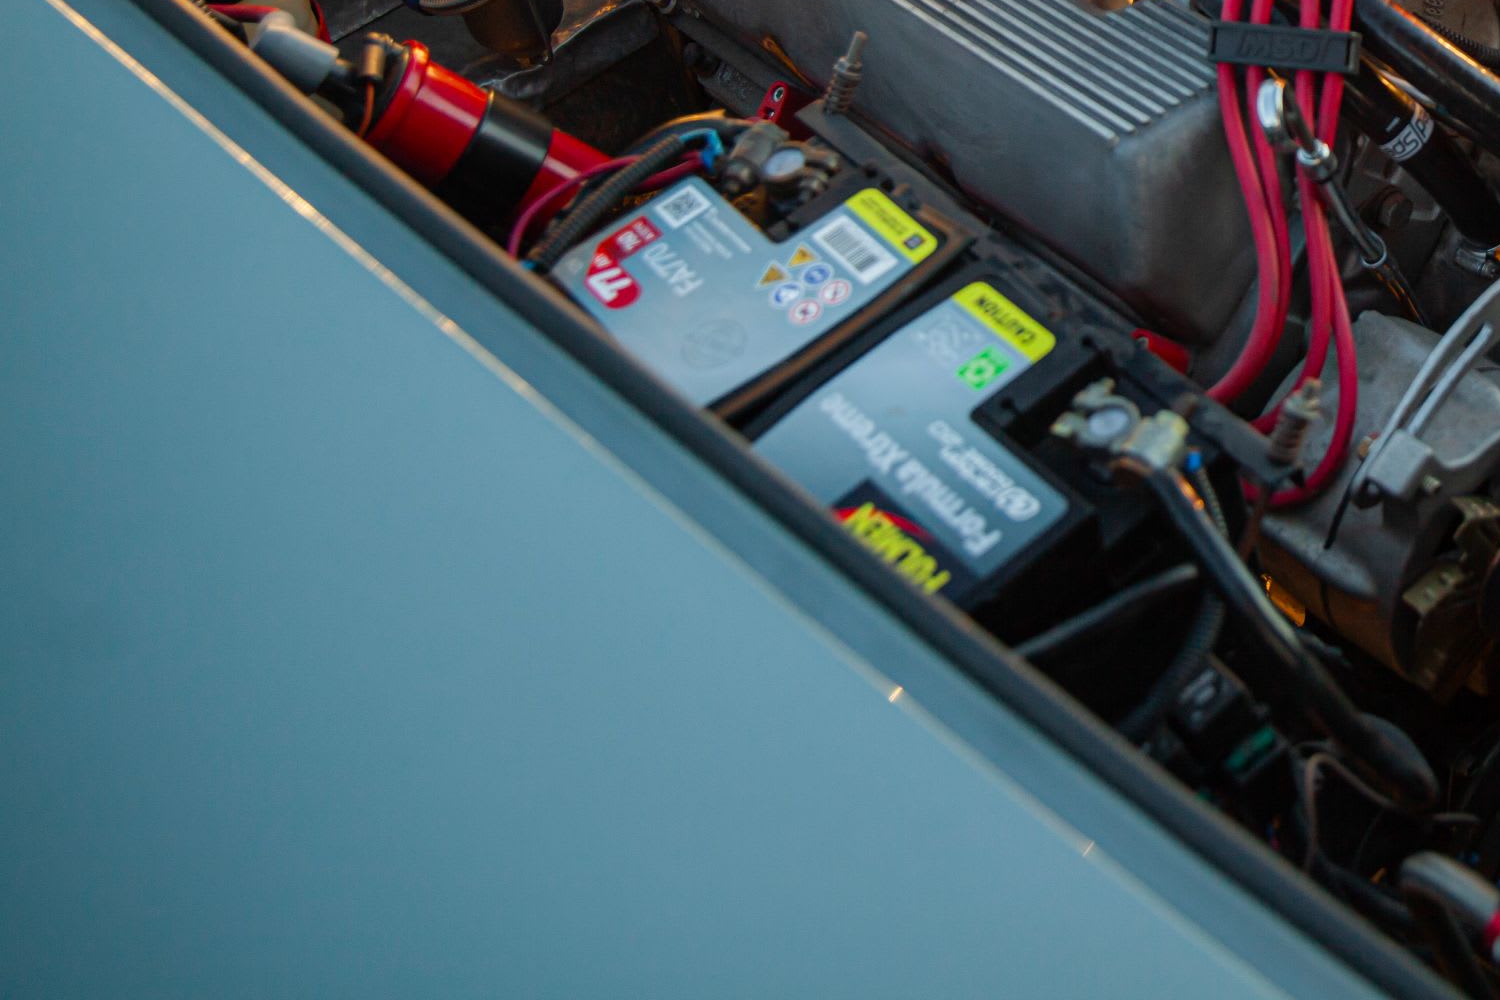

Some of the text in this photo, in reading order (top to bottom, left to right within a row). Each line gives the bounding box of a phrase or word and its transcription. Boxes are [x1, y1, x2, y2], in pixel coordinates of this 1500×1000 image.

[587, 266, 633, 304] 77
[975, 295, 1036, 345] CAUTION
[820, 392, 911, 474] Xtreme
[896, 456, 1003, 556] Formula
[842, 502, 951, 596] FULMEN
